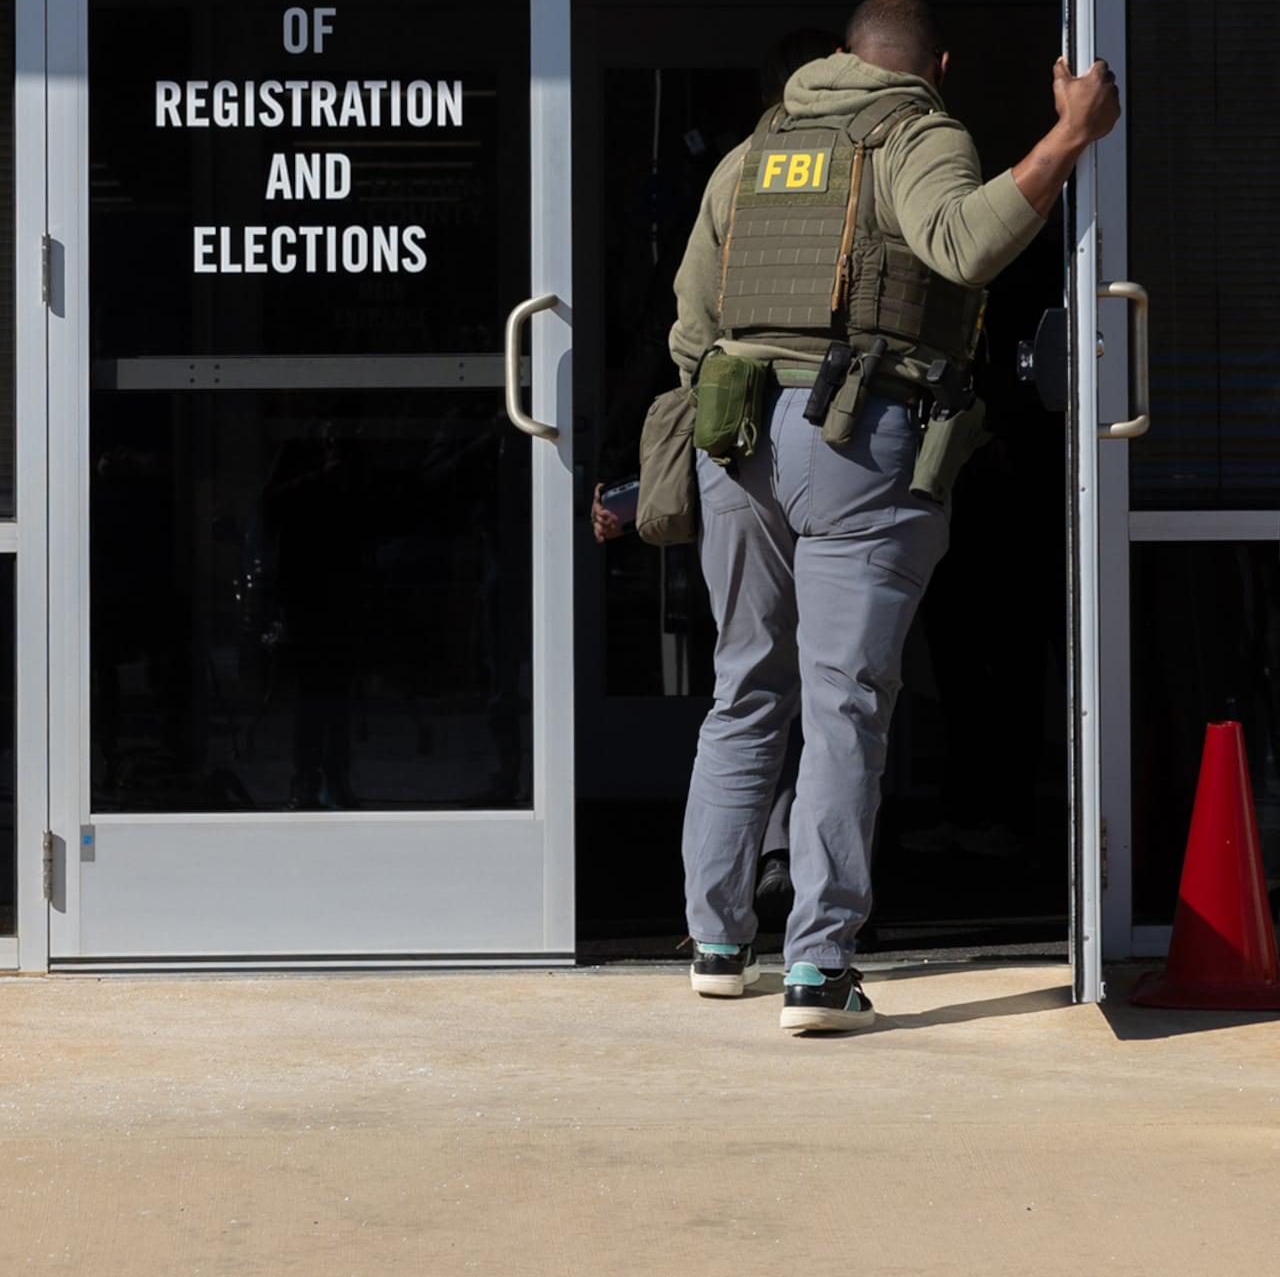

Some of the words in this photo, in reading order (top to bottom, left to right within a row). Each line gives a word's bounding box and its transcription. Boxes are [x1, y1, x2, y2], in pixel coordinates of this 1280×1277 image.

[283, 7, 336, 54] OF
[155, 80, 463, 128] REGISTRATION
[265, 152, 351, 200] AND
[762, 152, 824, 189] FBI
[193, 225, 427, 274] ELECTIONS
